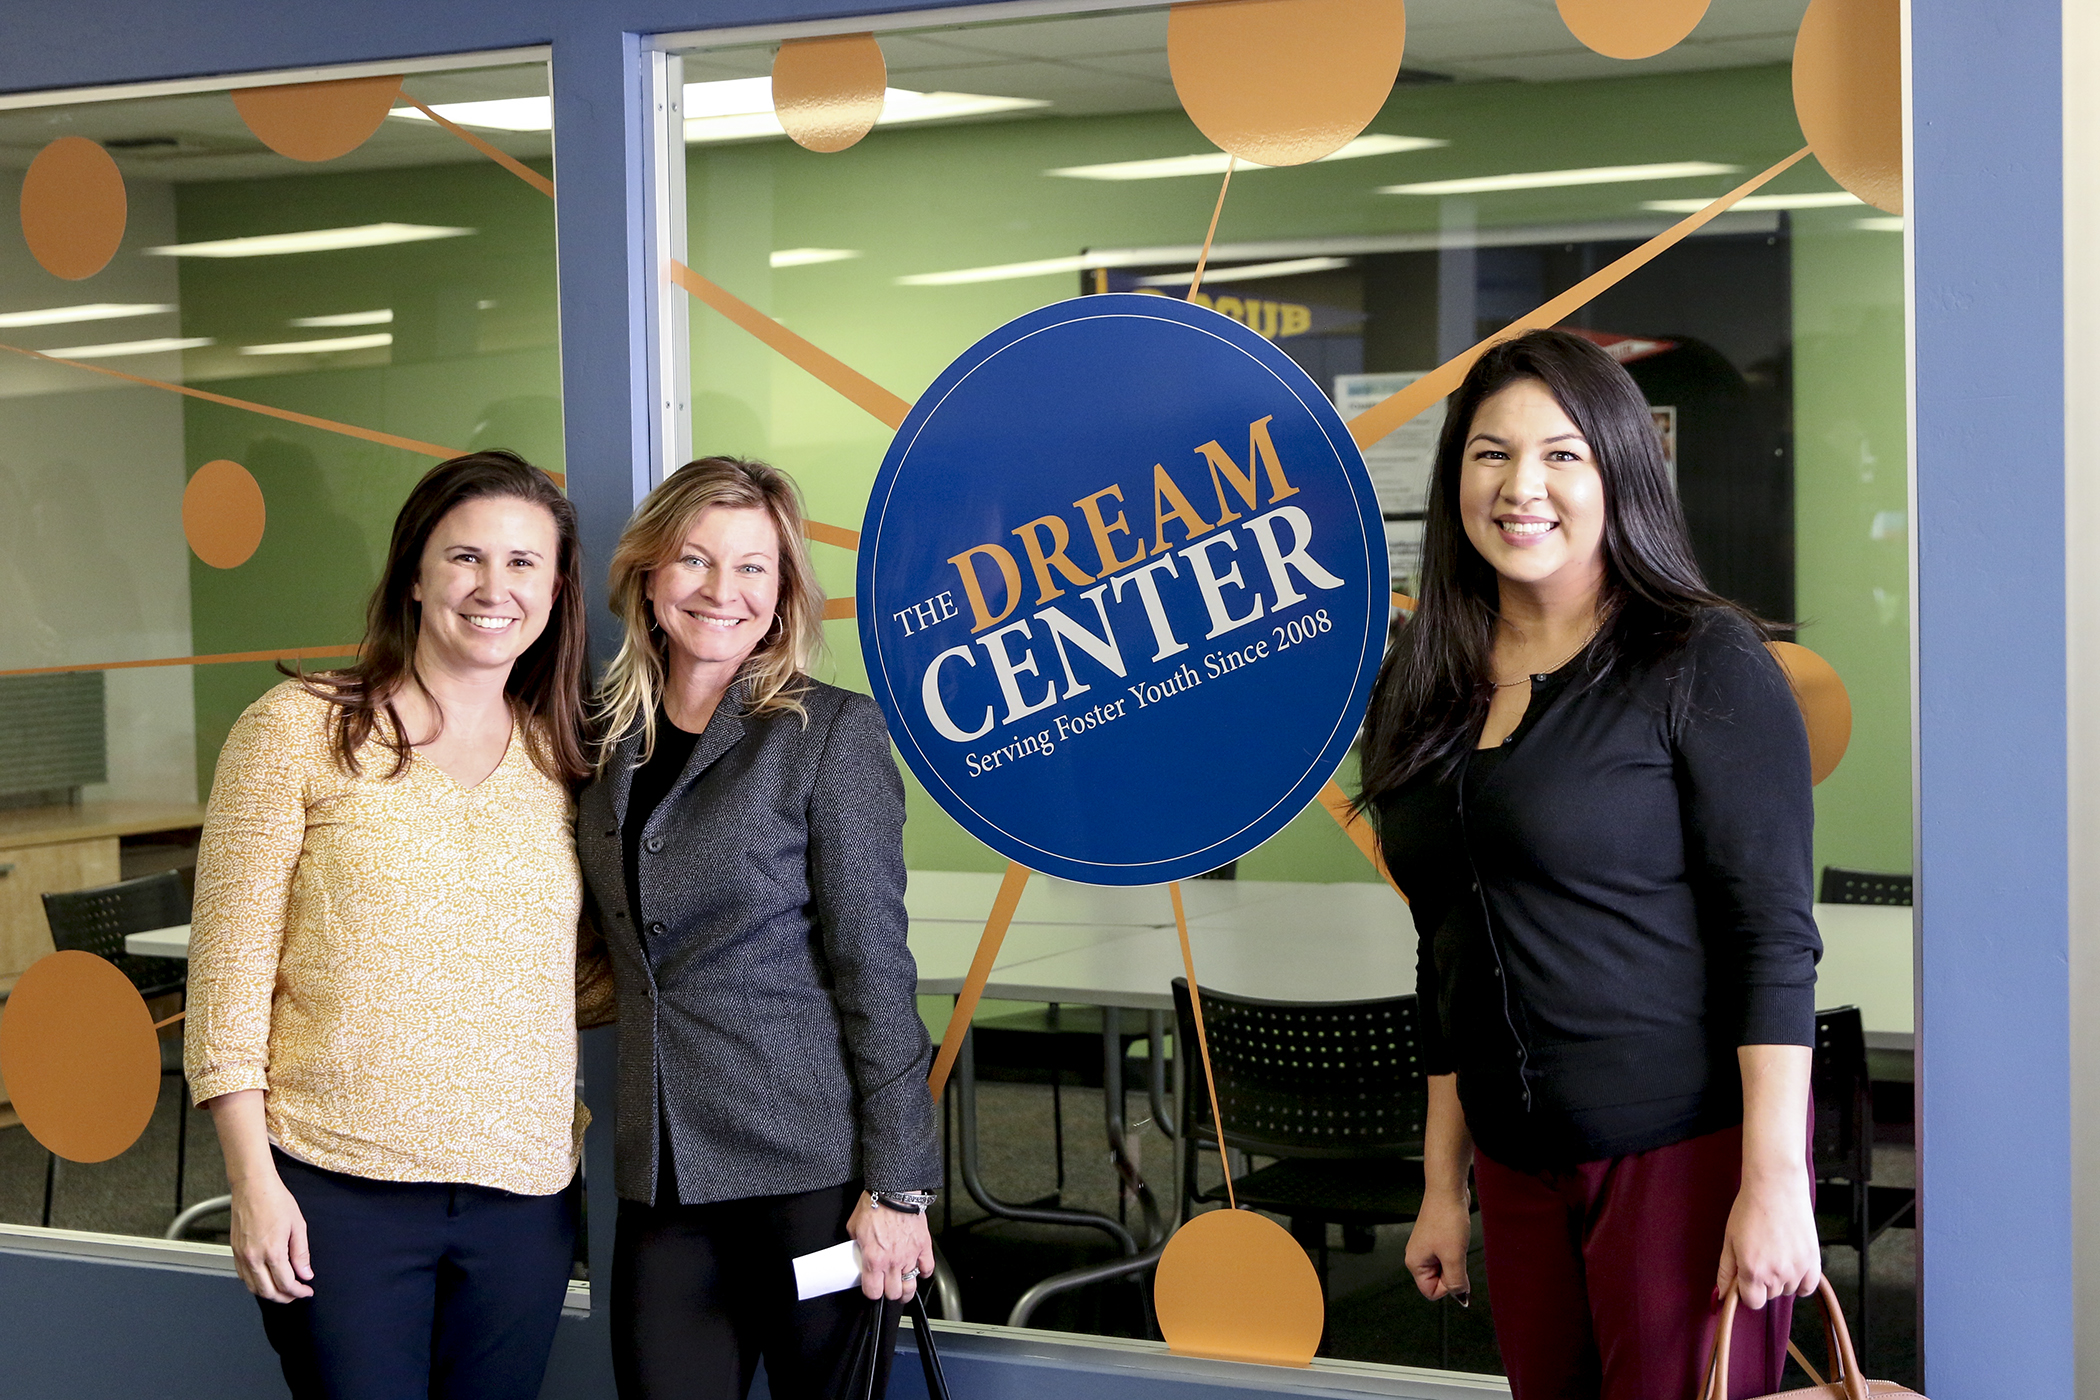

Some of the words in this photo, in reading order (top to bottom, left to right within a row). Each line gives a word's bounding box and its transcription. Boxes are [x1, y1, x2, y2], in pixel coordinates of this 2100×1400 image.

[893, 591, 958, 637] THE
[947, 415, 1299, 634] DREAM
[922, 506, 1344, 742] CENTER
[966, 730, 1054, 777] Serving
[1053, 699, 1126, 741] Foster
[1128, 664, 1202, 708] Youth
[1204, 641, 1269, 679] Since
[1273, 609, 1331, 651] 2008
